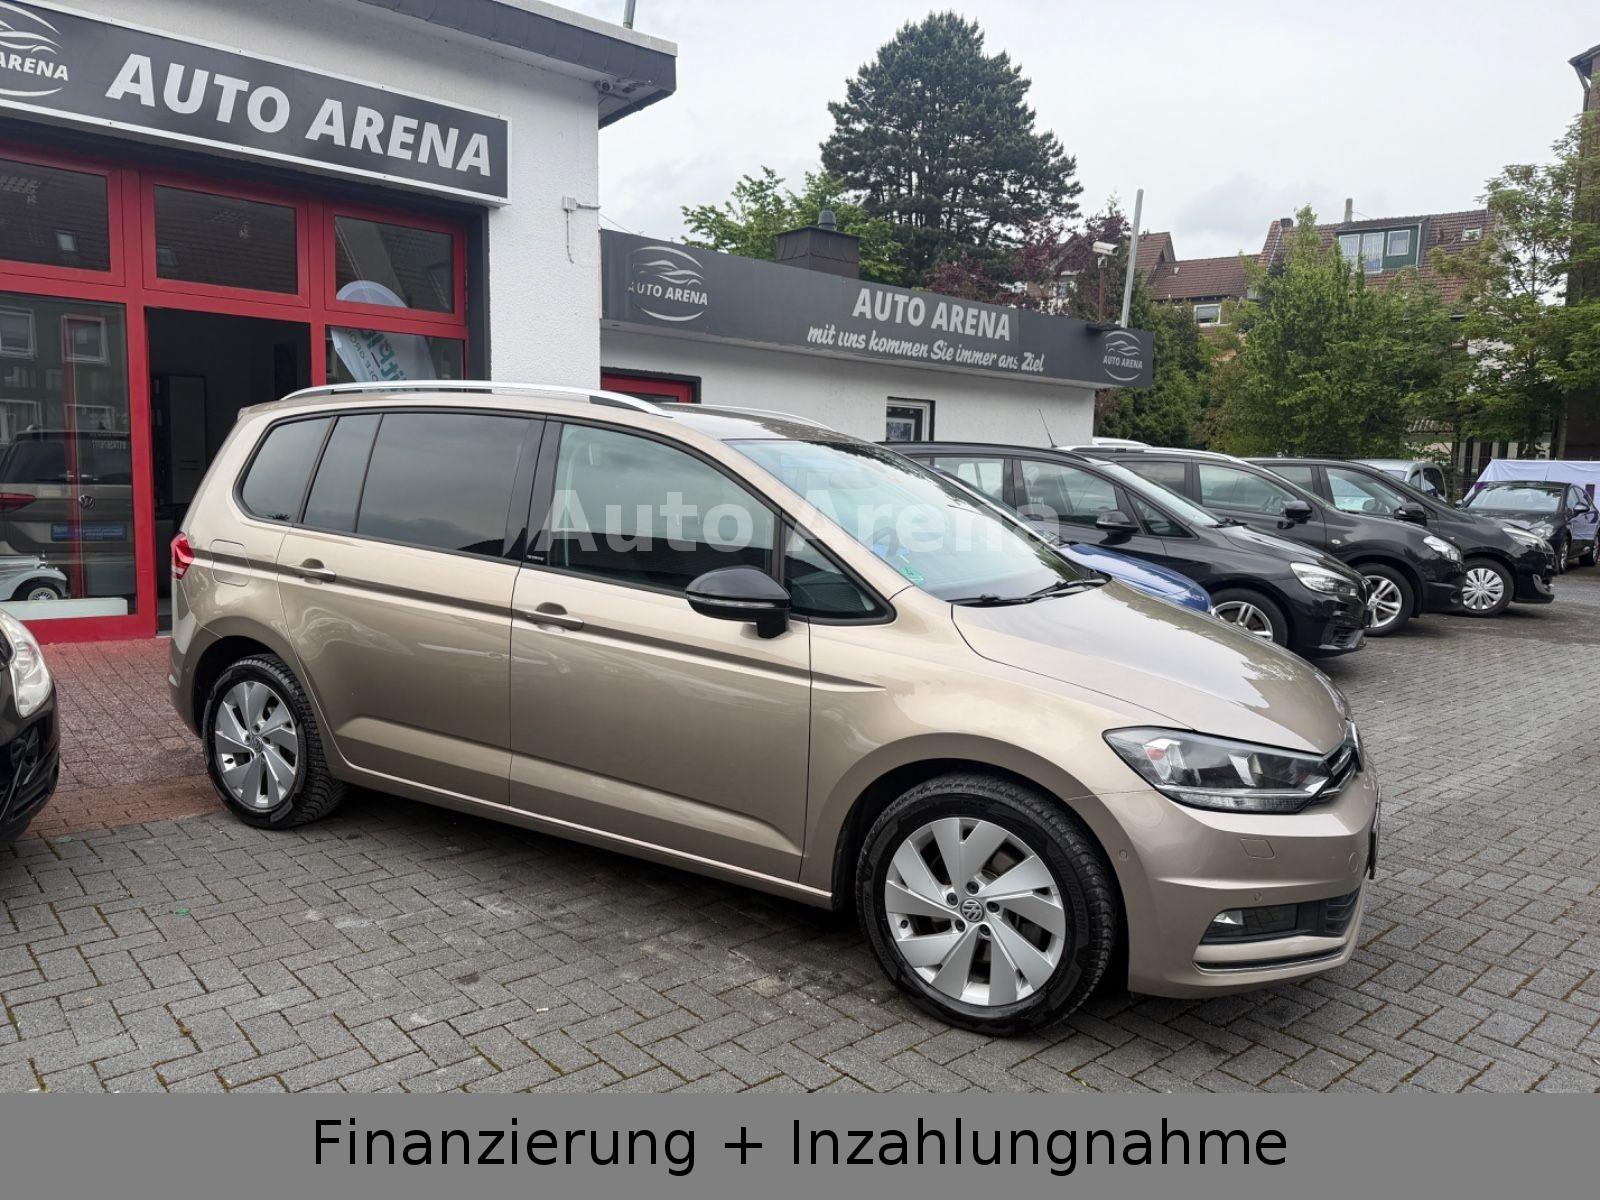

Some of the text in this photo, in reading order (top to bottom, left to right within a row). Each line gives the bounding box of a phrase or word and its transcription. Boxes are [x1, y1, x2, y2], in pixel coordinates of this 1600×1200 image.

[105, 53, 491, 177] AUTO ARENA
[664, 287, 708, 305] ARENA
[852, 287, 1010, 341] AUTO ARENA
[807, 323, 836, 345] mit
[837, 331, 867, 349] uns
[868, 330, 929, 358] kommen
[930, 339, 954, 361] Sie
[955, 344, 997, 366] immer
[1021, 351, 1045, 372] Ziel
[1103, 355, 1143, 369] AUTO ARENA
